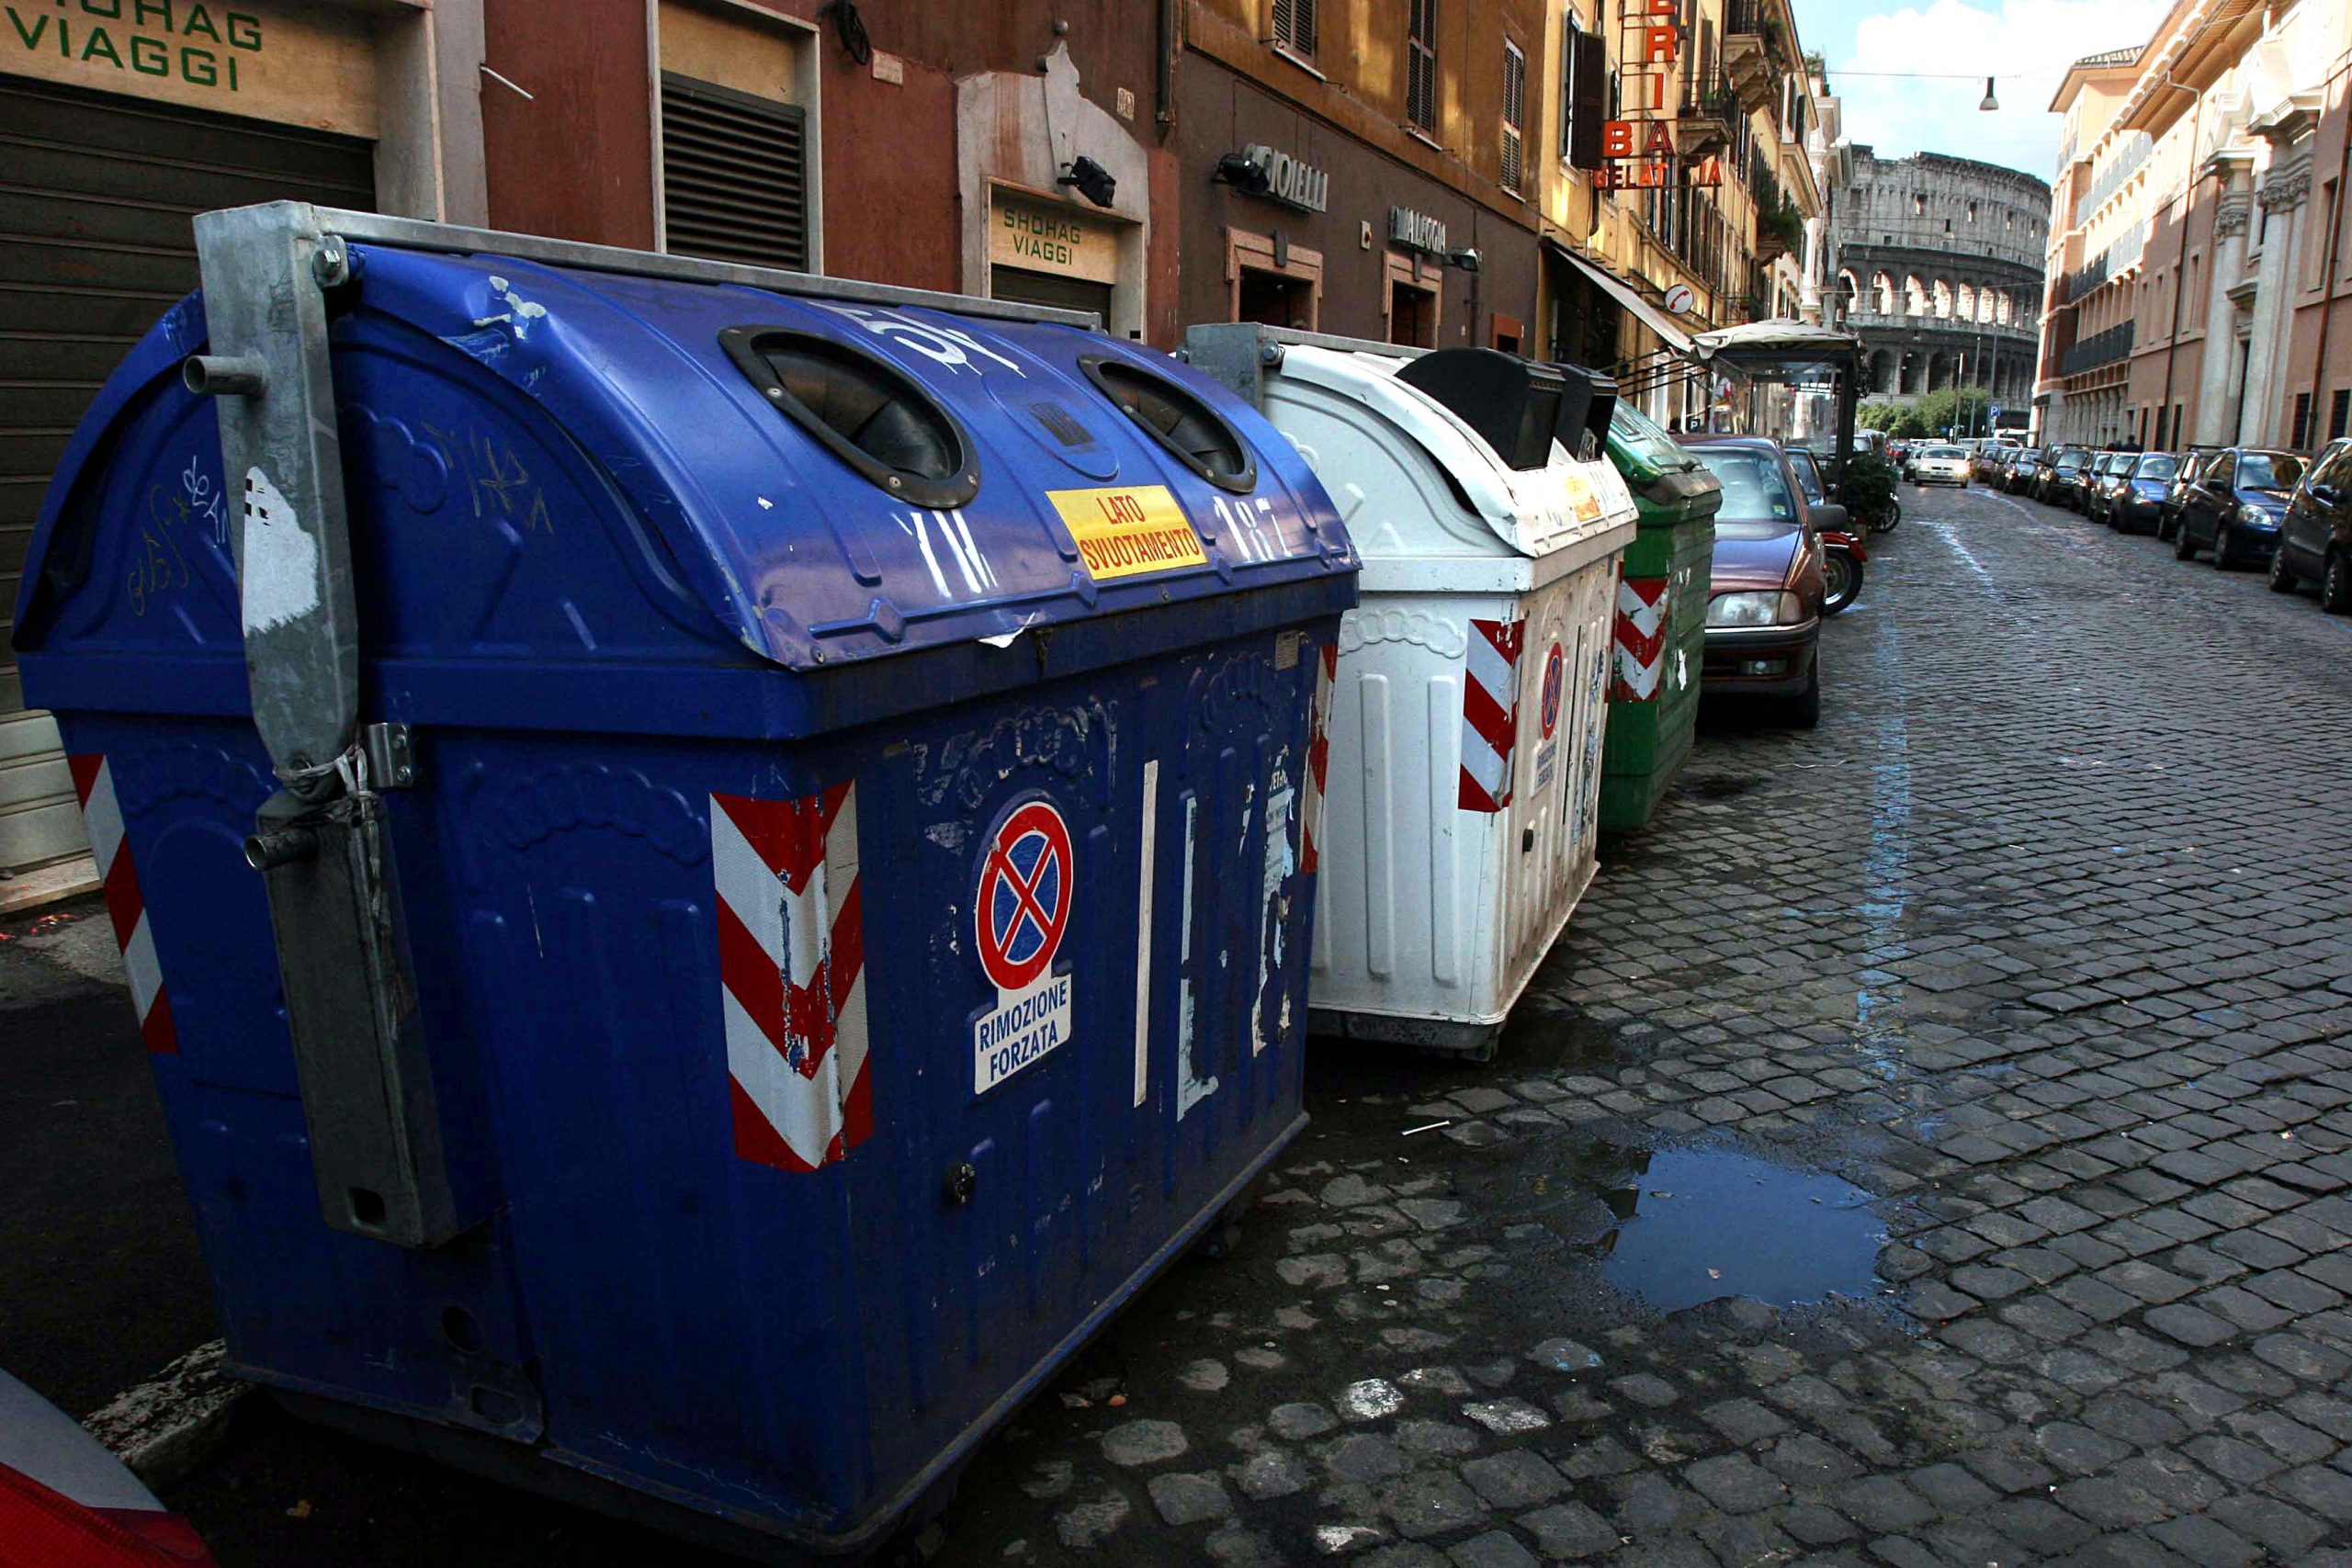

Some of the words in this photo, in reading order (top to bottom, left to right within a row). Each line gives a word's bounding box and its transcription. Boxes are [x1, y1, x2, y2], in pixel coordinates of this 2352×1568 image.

[5, 6, 239, 92] VIAGGI
[1004, 208, 1080, 244] SHOHAG
[1012, 234, 1072, 265] VIAGGI
[1990, 406, 1998, 416] P
[1096, 494, 1146, 525] LATO
[1213, 496, 1294, 561] 187
[1080, 527, 1201, 571] SVUOTAMENTO
[979, 980, 1068, 1052] RIMOZIONE
[989, 1020, 1058, 1082] FORZATA
